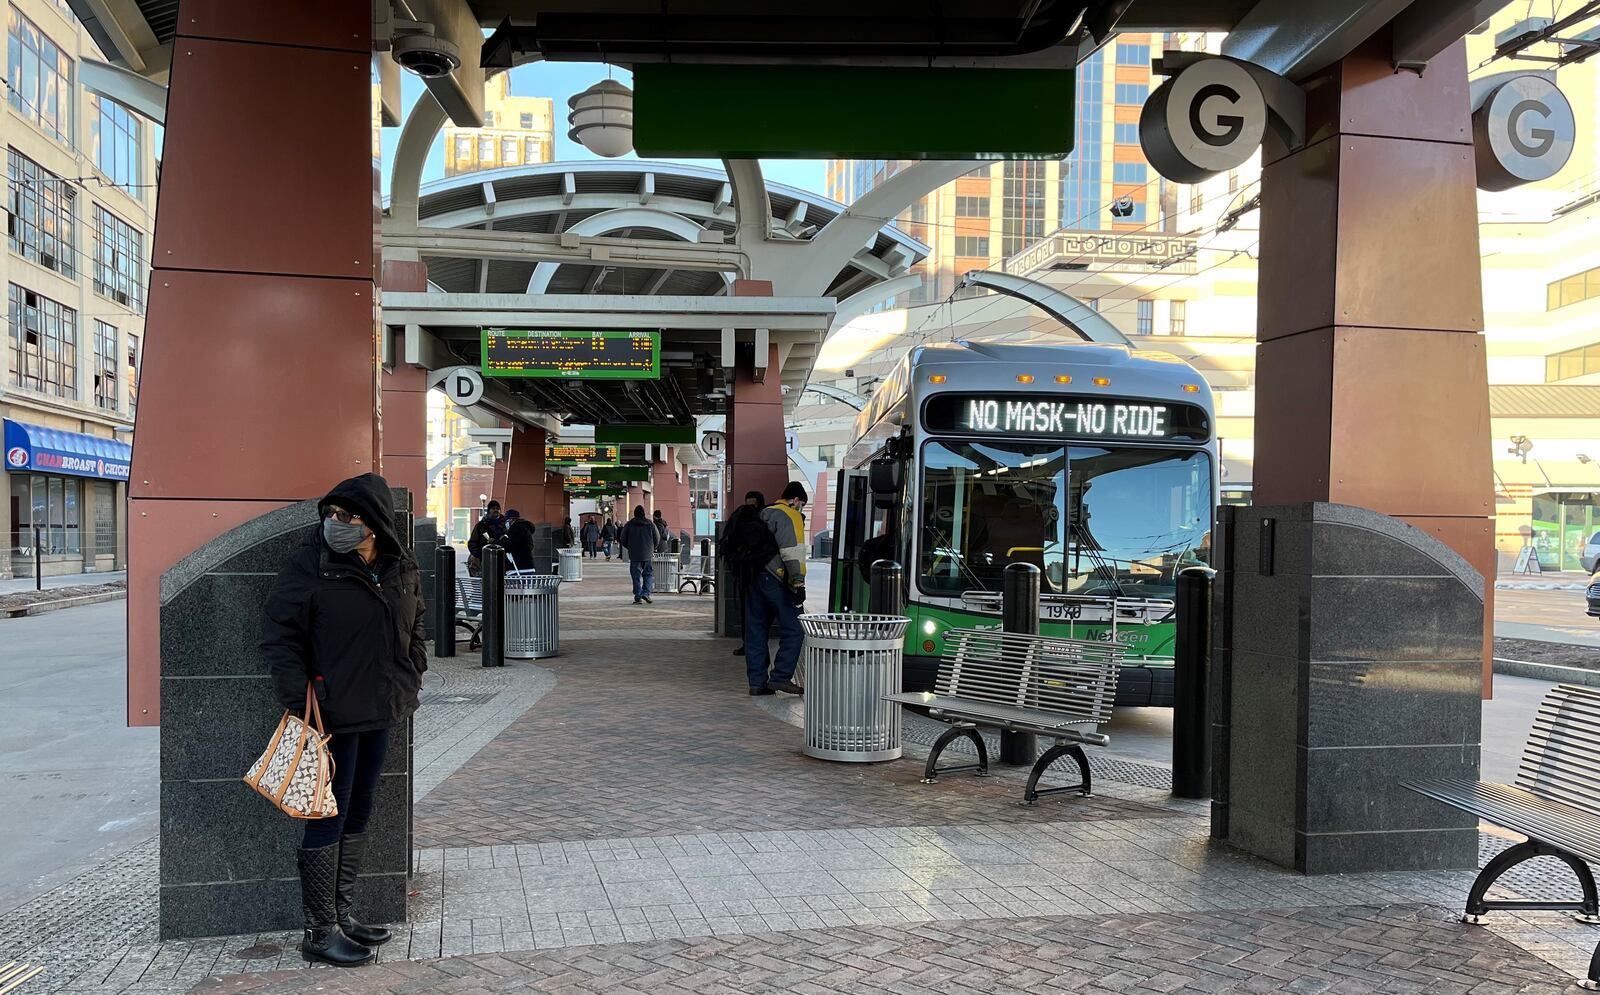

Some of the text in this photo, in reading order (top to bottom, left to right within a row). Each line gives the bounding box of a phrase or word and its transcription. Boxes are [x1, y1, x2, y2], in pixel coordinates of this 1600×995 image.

[1188, 83, 1245, 147] G
[1507, 99, 1556, 158] G
[456, 375, 475, 398] D
[969, 400, 1167, 436] NO MASK-NO RIDE
[709, 436, 720, 451] H
[36, 452, 130, 477] CHARBROAST CHICK
